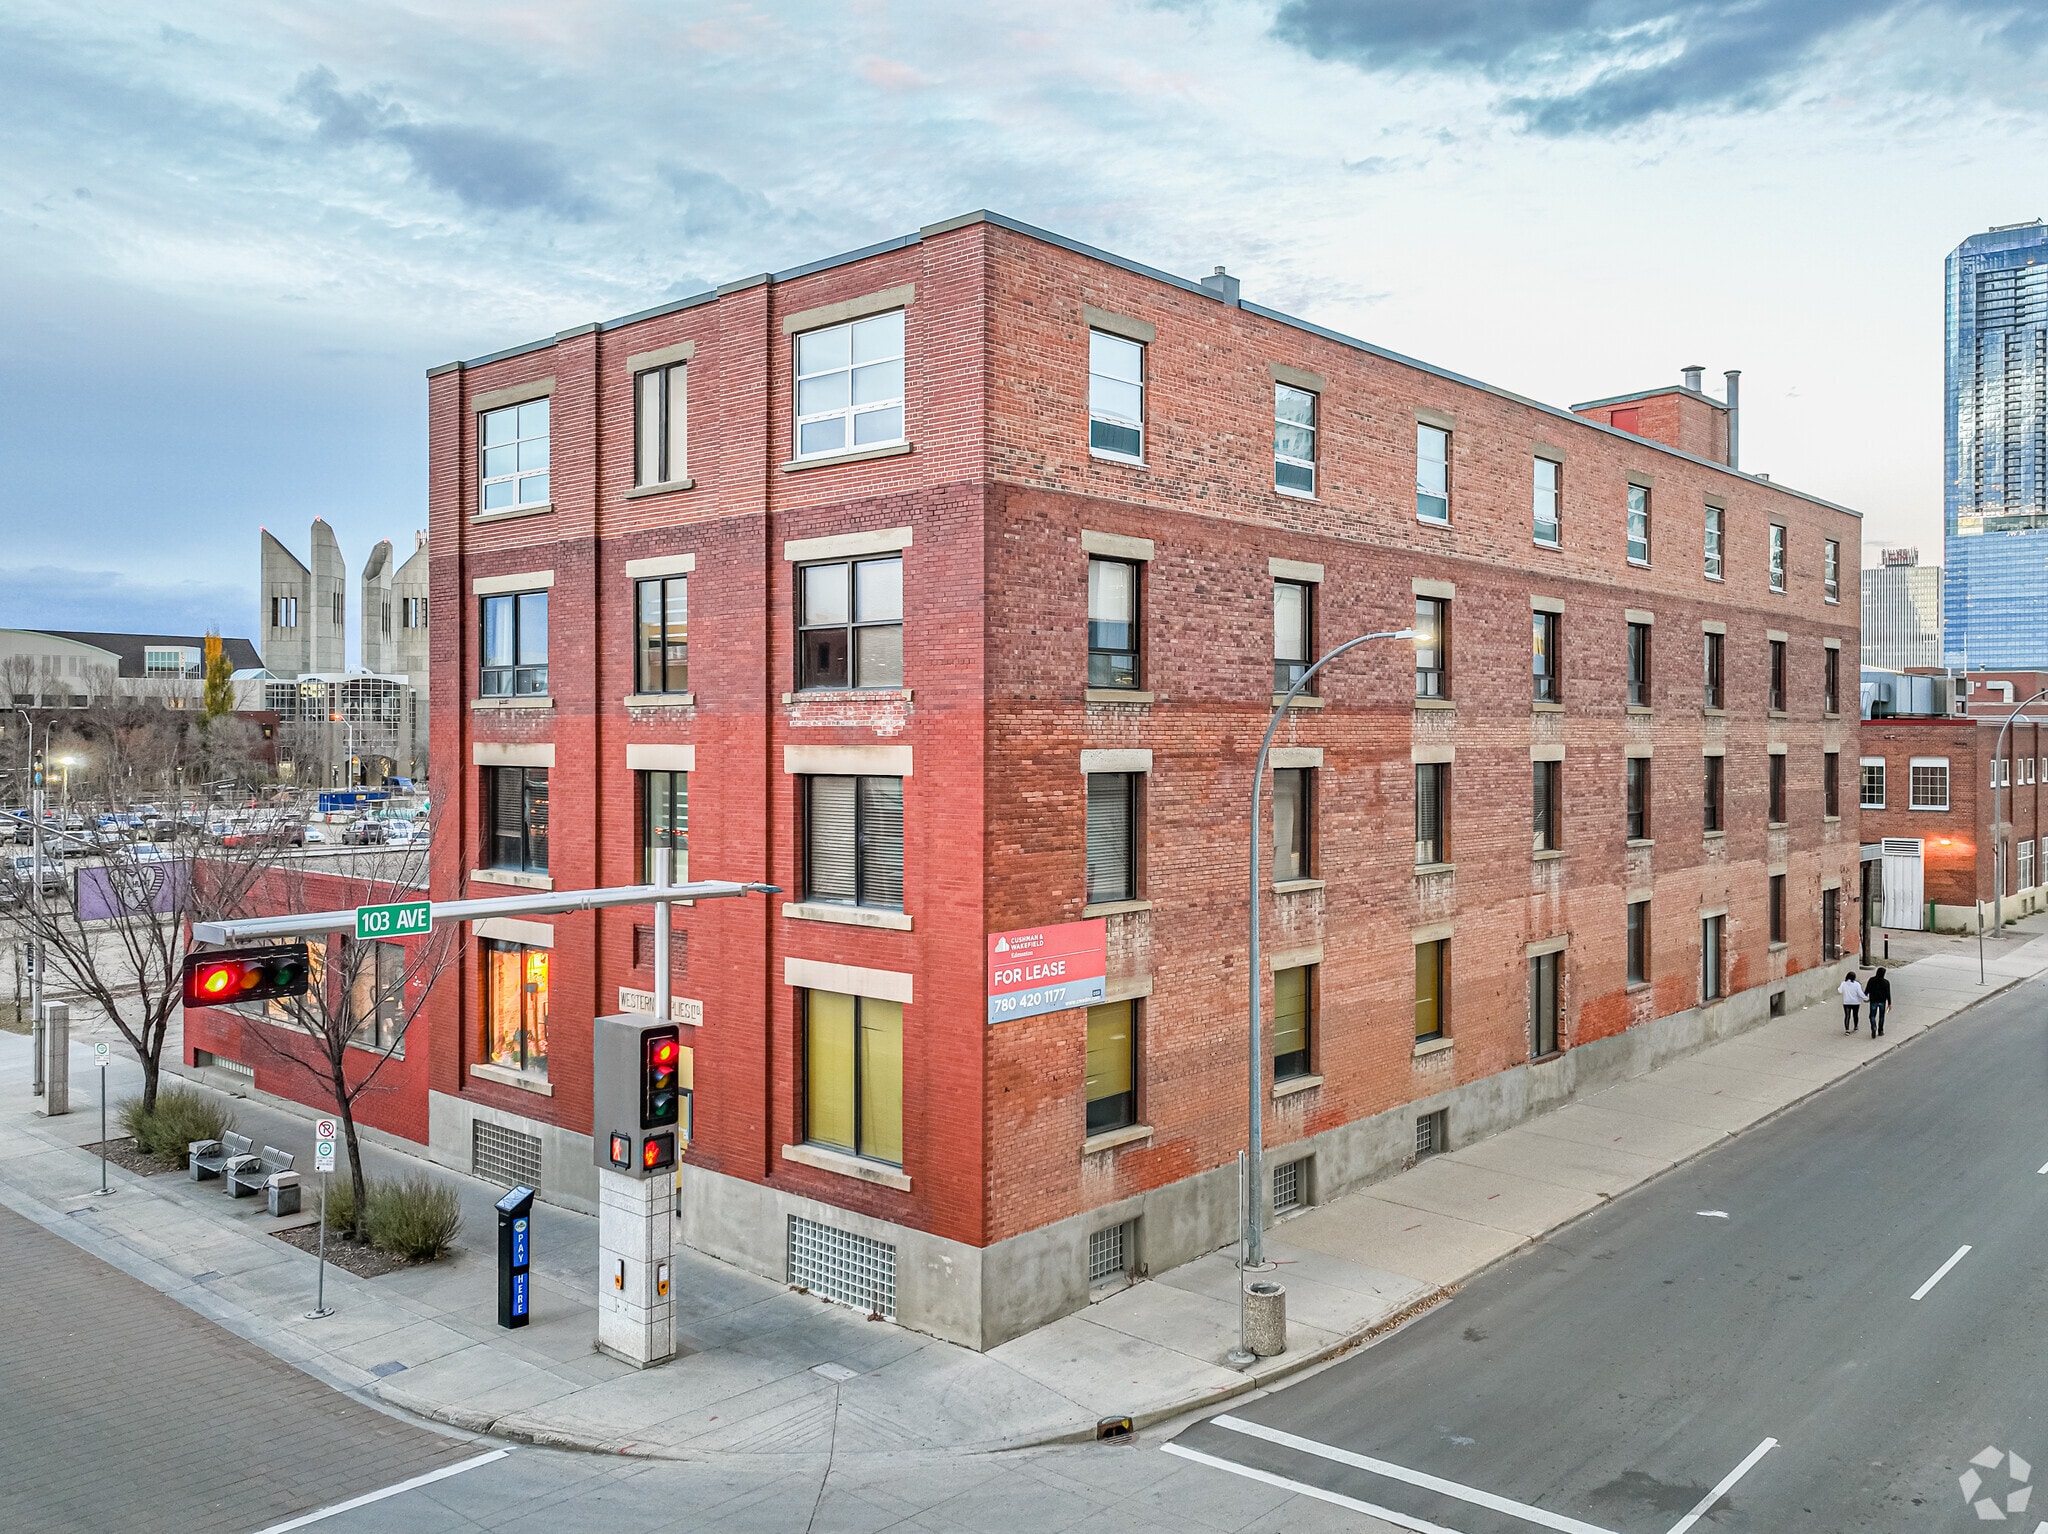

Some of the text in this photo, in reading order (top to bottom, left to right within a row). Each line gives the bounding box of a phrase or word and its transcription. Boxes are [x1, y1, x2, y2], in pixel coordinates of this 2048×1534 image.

[361, 908, 427, 932] 103 AVE
[1011, 934, 1038, 944] CUSHMAN
[1011, 940, 1044, 951] WAKEFIELD
[994, 960, 1066, 986] FOR LEASE
[620, 991, 655, 1013] WESTERN
[994, 988, 1067, 1014] 780 420 1177
